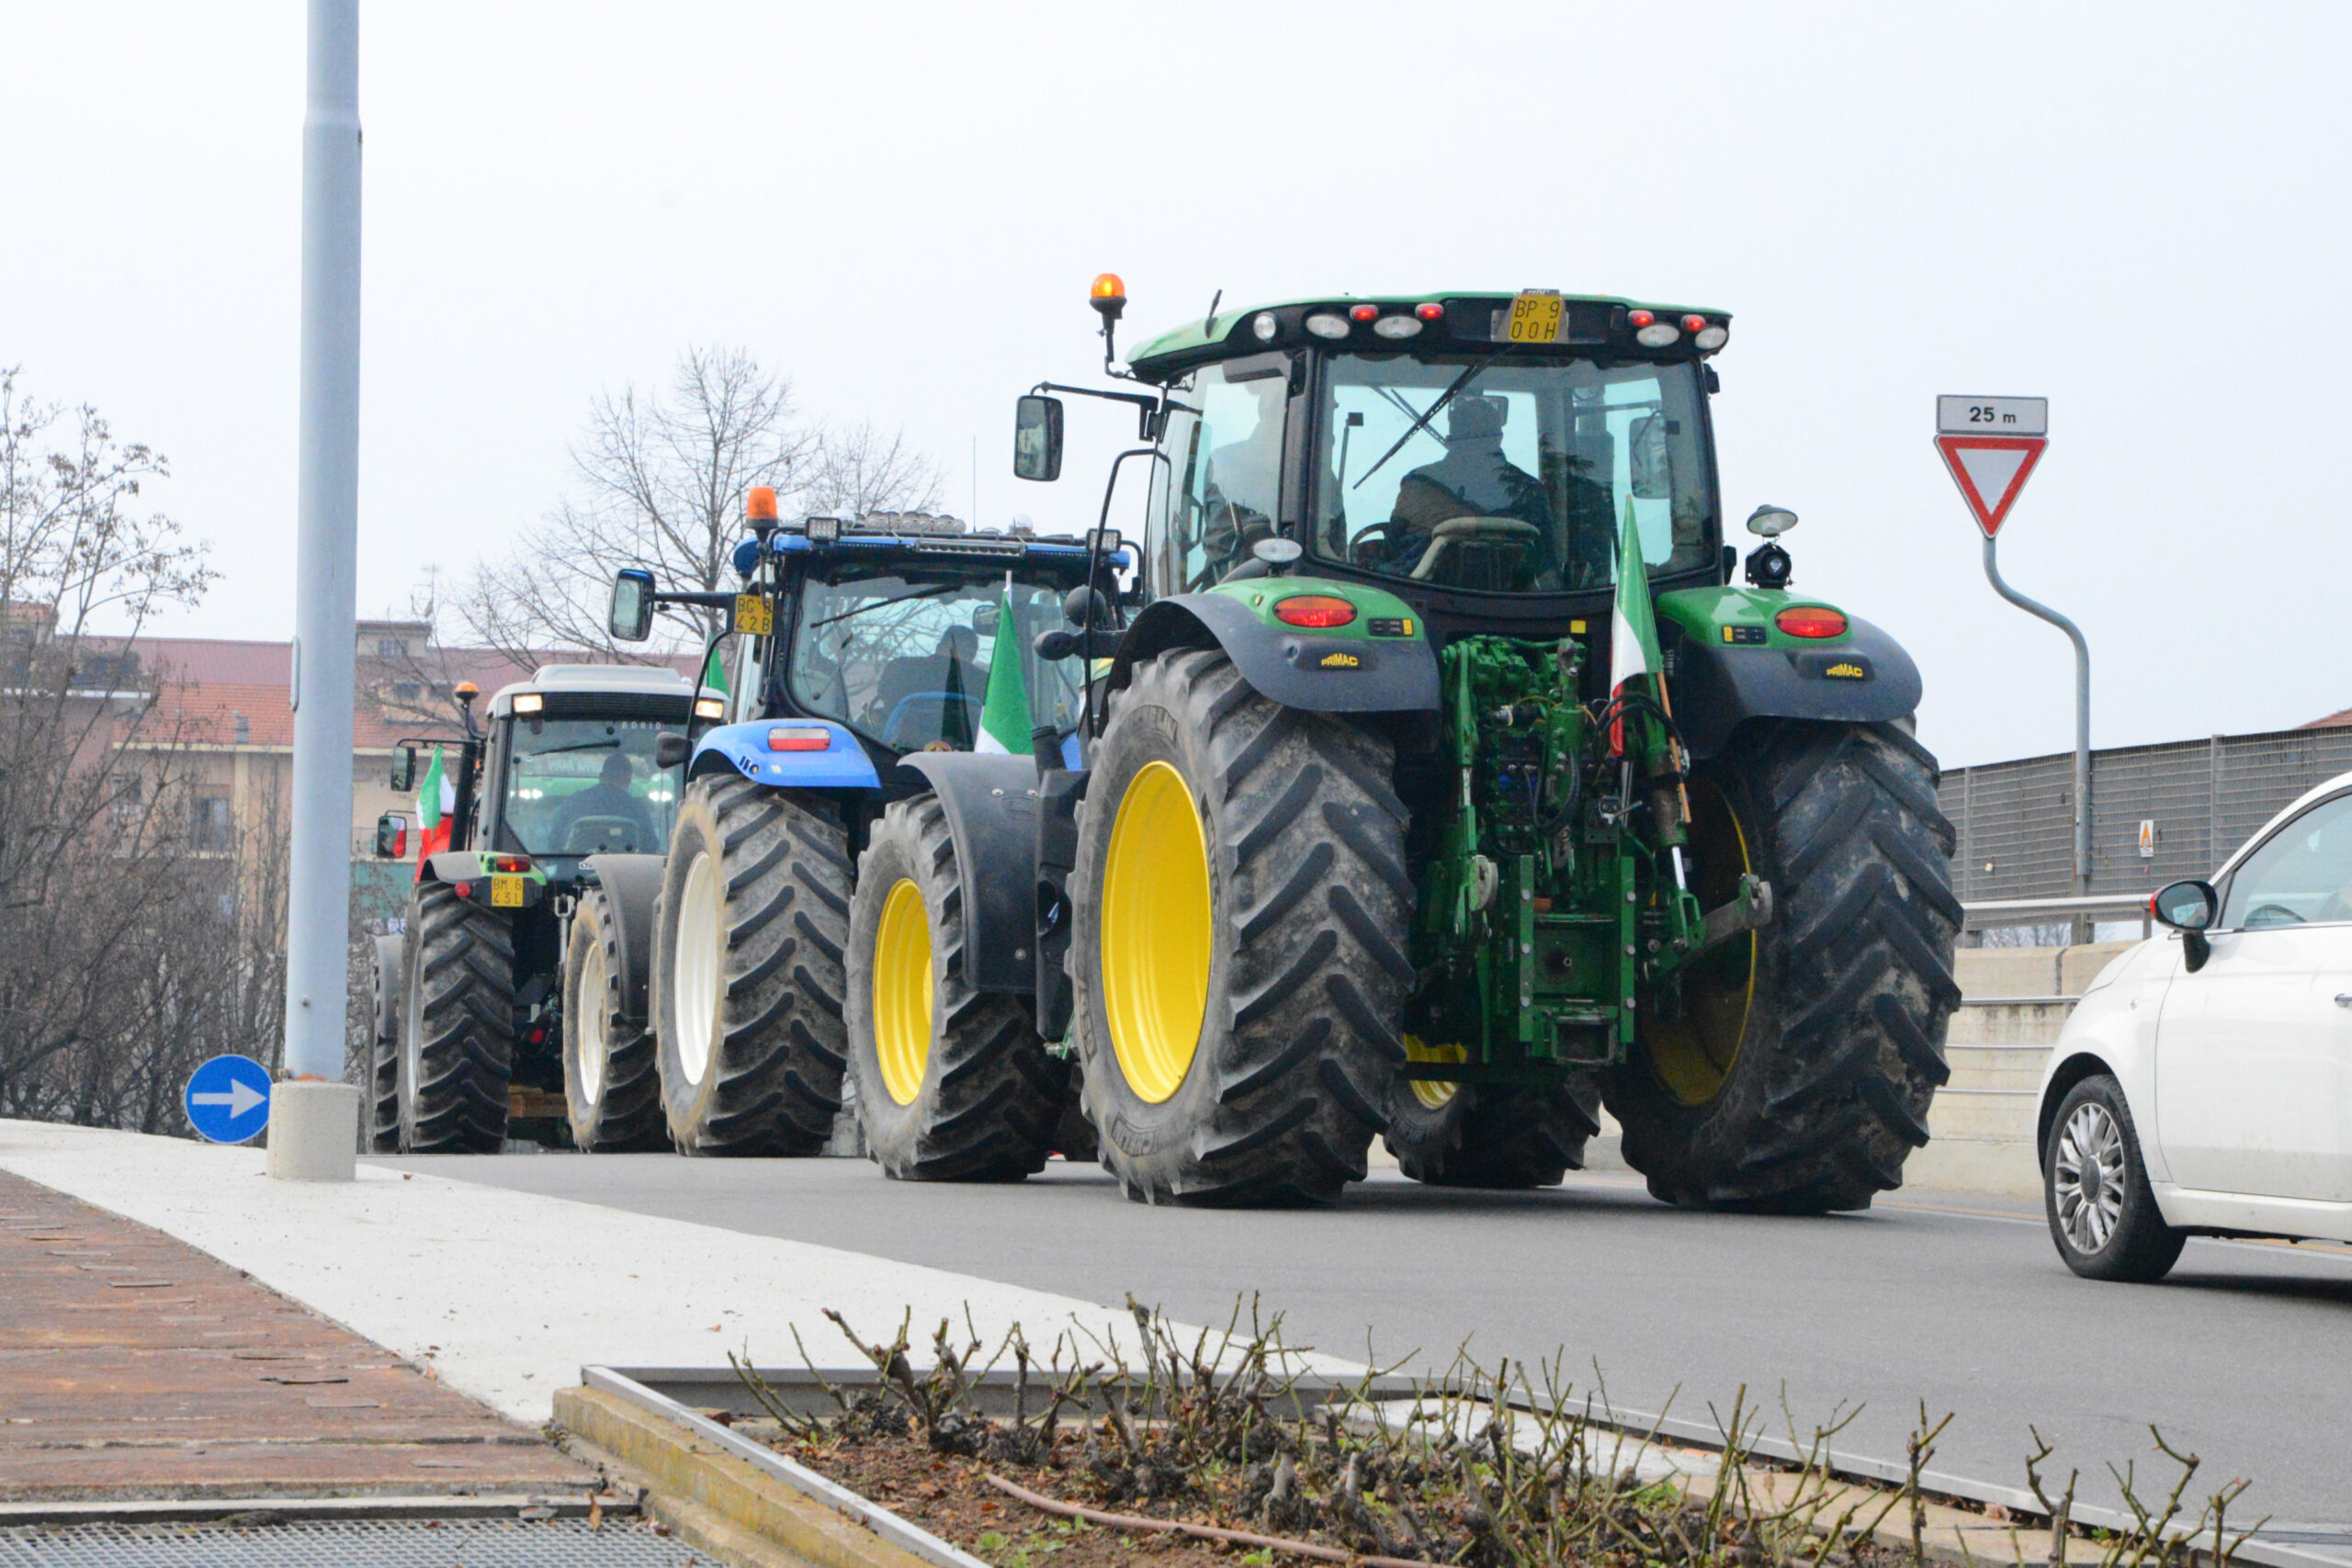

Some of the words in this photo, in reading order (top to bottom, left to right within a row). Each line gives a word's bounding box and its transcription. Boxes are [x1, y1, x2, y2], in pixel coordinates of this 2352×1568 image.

[1514, 299, 1537, 318] BP
[1549, 300, 1560, 319] 9
[1969, 406, 1995, 423] 25
[2002, 413, 2016, 423] m
[738, 598, 755, 614] BG
[1321, 653, 1359, 666] PRIMAC
[1826, 663, 1863, 677] PRIMAC
[492, 878, 508, 891] BM
[514, 878, 523, 892] 6
[492, 892, 523, 905] 43L
